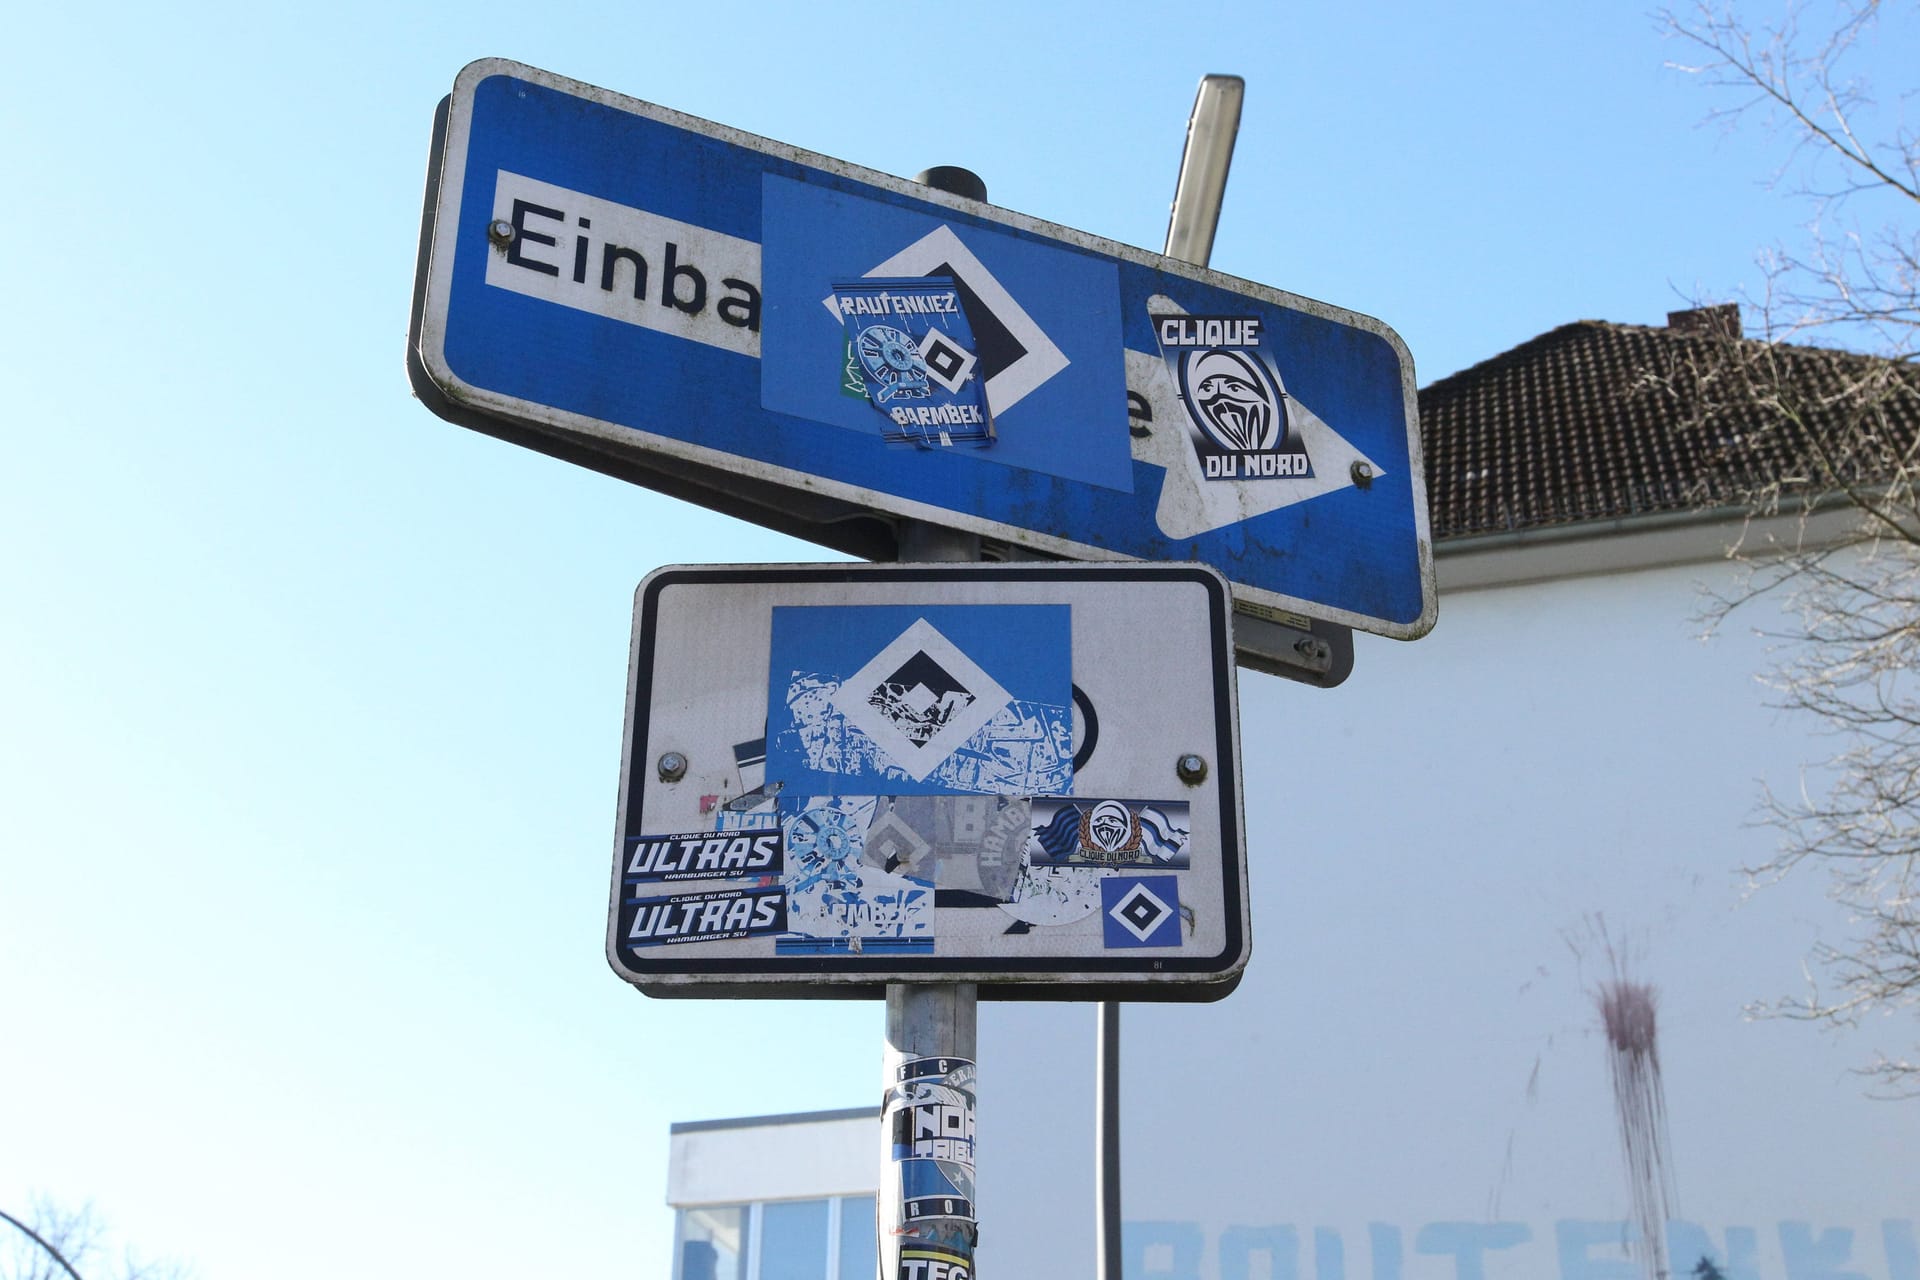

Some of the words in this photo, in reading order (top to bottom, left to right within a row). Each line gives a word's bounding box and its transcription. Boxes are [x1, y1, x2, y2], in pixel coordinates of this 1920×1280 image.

[840, 292, 958, 315] RAUTENKIEZ
[1161, 319, 1260, 348] CLIQUE
[891, 403, 984, 425] BARMBEK
[1206, 455, 1237, 478] DU
[1244, 453, 1308, 478] NORD
[704, 831, 716, 839] DU
[627, 835, 780, 874] ULTRAS
[1080, 849, 1105, 860] CLIQUE
[1106, 851, 1118, 862] DU
[664, 870, 727, 880] HAMBURGER
[704, 893, 717, 901] DU
[717, 891, 742, 900] NORD
[628, 894, 782, 939] ULTRAS
[666, 932, 730, 944] HAMBURGER
